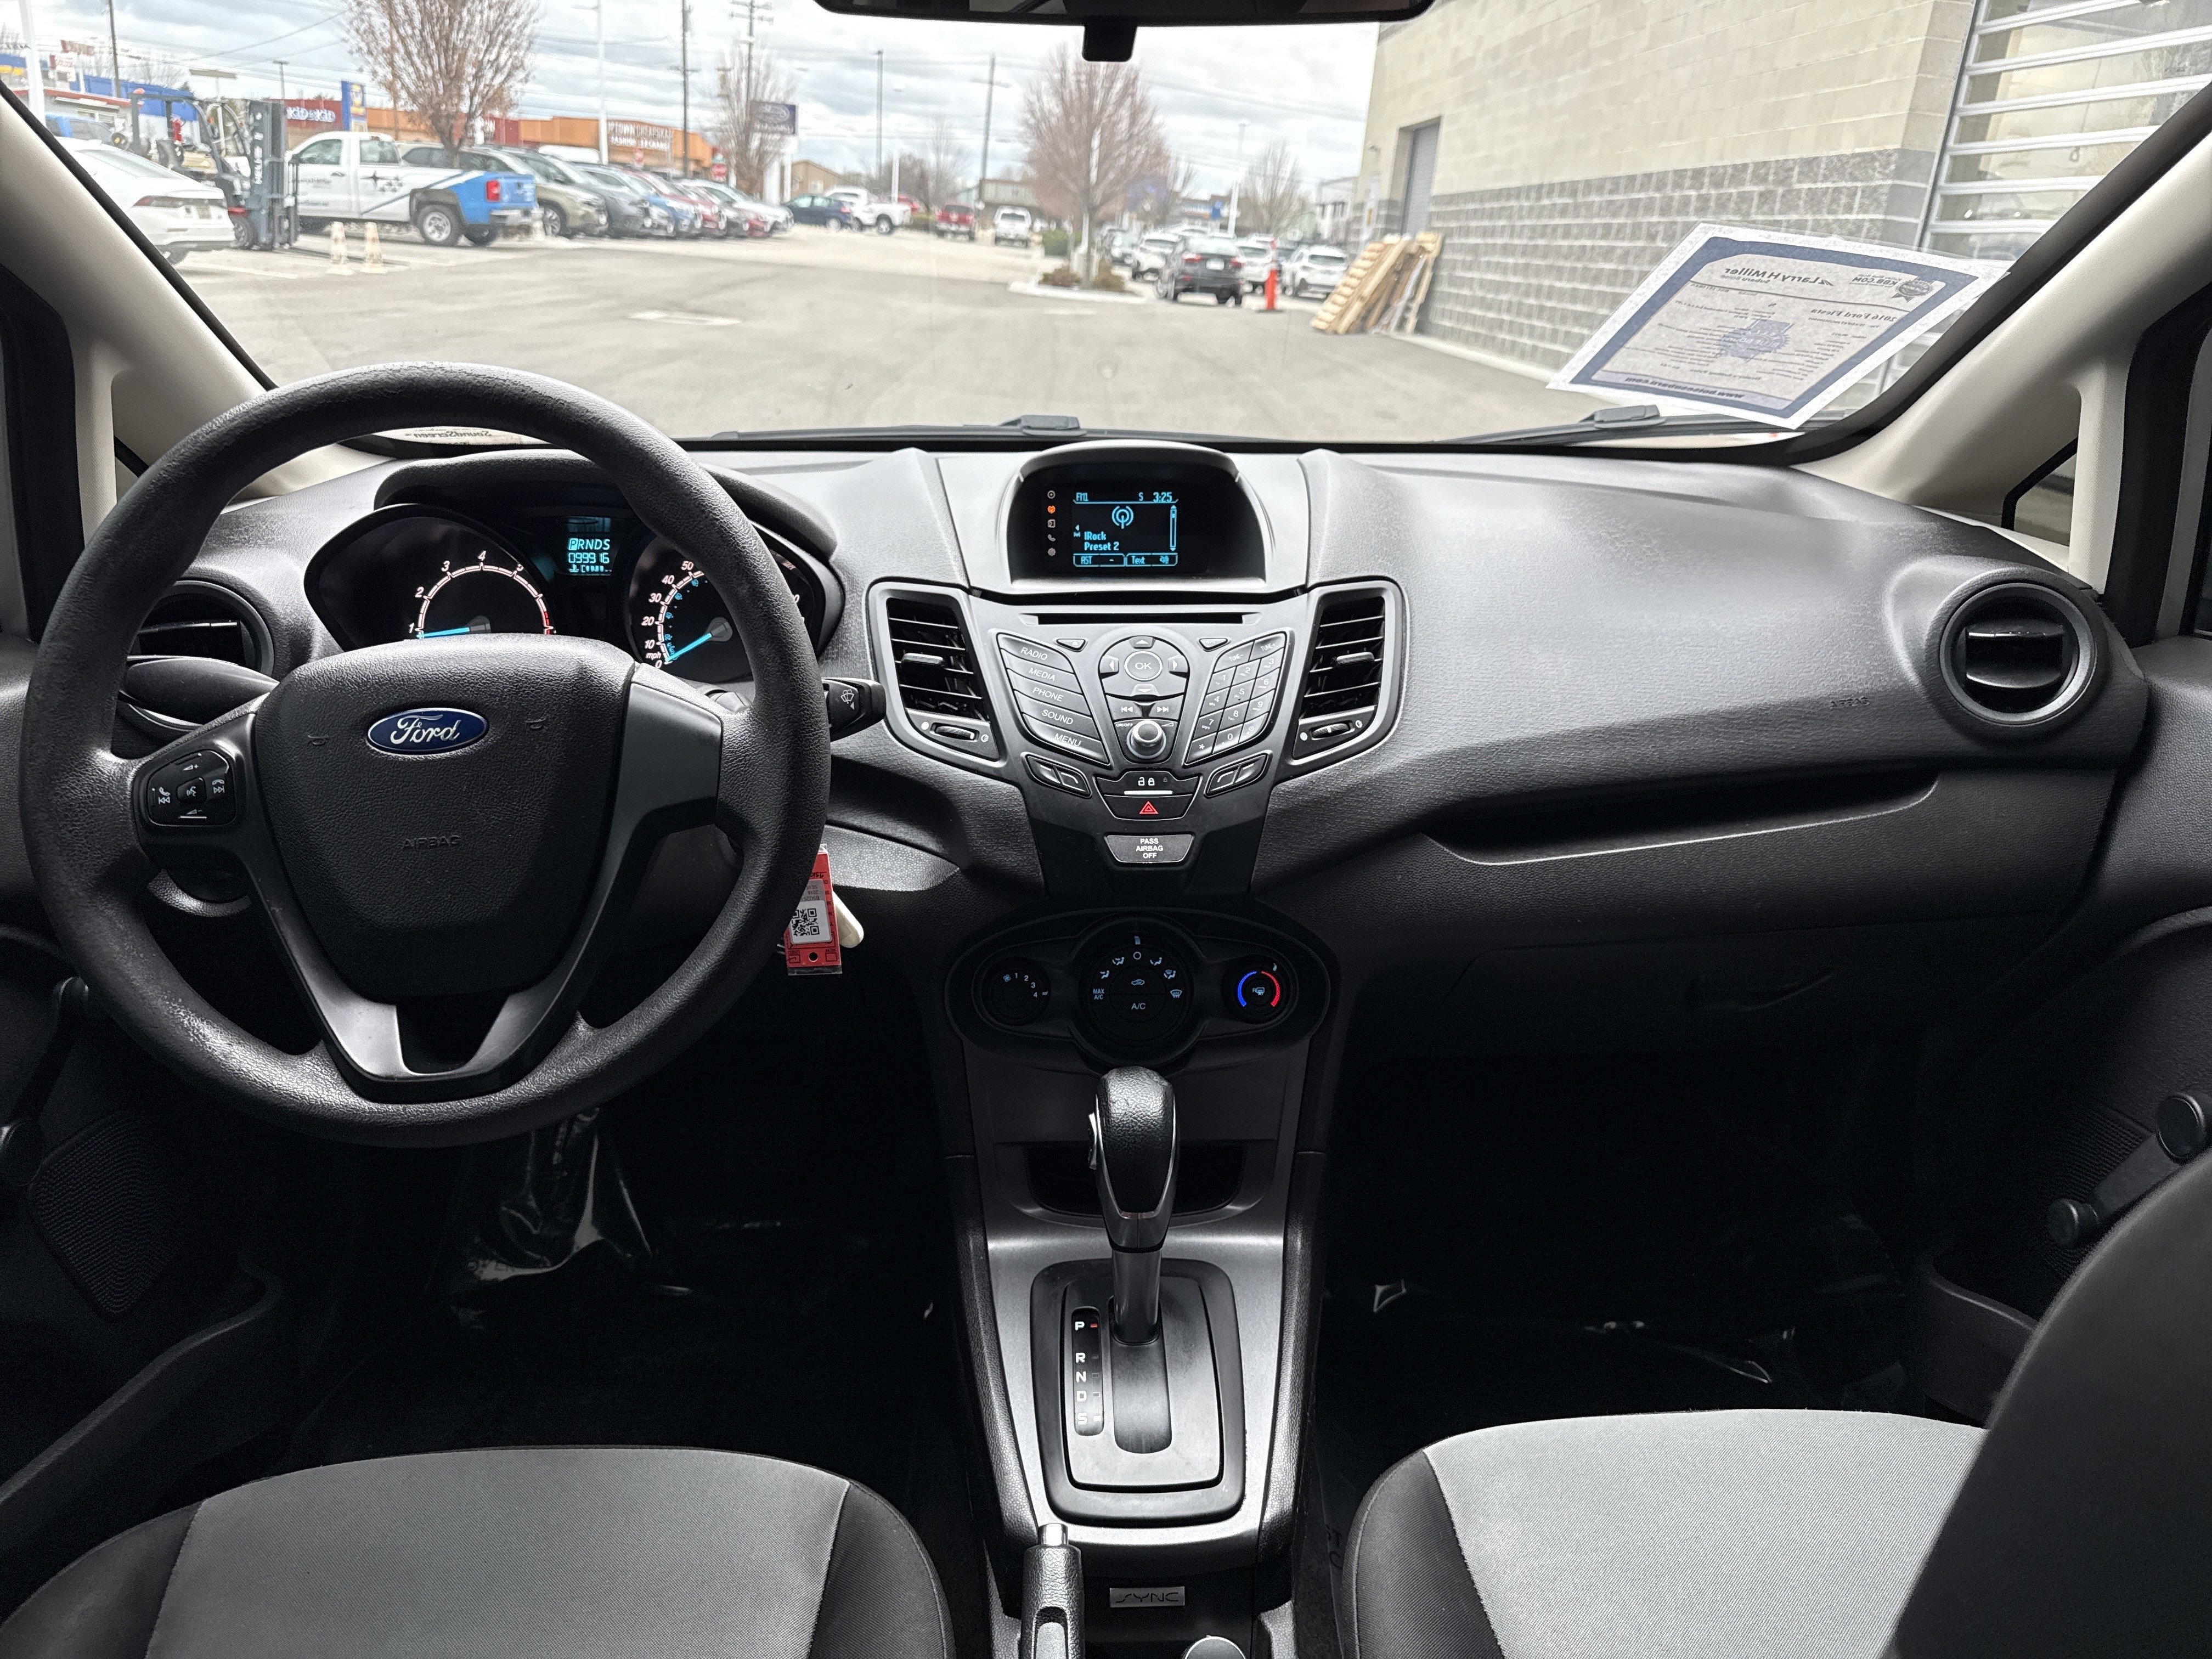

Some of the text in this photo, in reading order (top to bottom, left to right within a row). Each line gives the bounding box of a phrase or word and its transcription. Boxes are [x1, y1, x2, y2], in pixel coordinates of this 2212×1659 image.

[1153, 491, 1172, 503] 3:25
[1084, 541, 1120, 551] Preset 2
[478, 550, 487, 561] 4
[1131, 555, 1146, 565] Text
[441, 561, 450, 572] 3
[681, 560, 694, 571] 50
[661, 574, 675, 585] 40
[415, 586, 424, 598] 2
[648, 592, 662, 603] 30
[641, 616, 655, 626] 20
[409, 622, 415, 633] 1
[645, 639, 656, 649] 10
[646, 651, 662, 659] mph
[1020, 646, 1048, 661] RADIO
[654, 659, 663, 669] 0
[1028, 667, 1056, 681] MEDIA
[1032, 687, 1064, 702] PHONE
[1041, 709, 1074, 725] SOUND
[390, 714, 462, 744] Ford
[1054, 733, 1082, 747] MENU
[1075, 1321, 1085, 1330] P
[1075, 1352, 1086, 1363] R
[1076, 1371, 1087, 1382] N
[1076, 1390, 1087, 1401] D
[1077, 1413, 1088, 1425] S
[1115, 1592, 1180, 1603] SYNC
